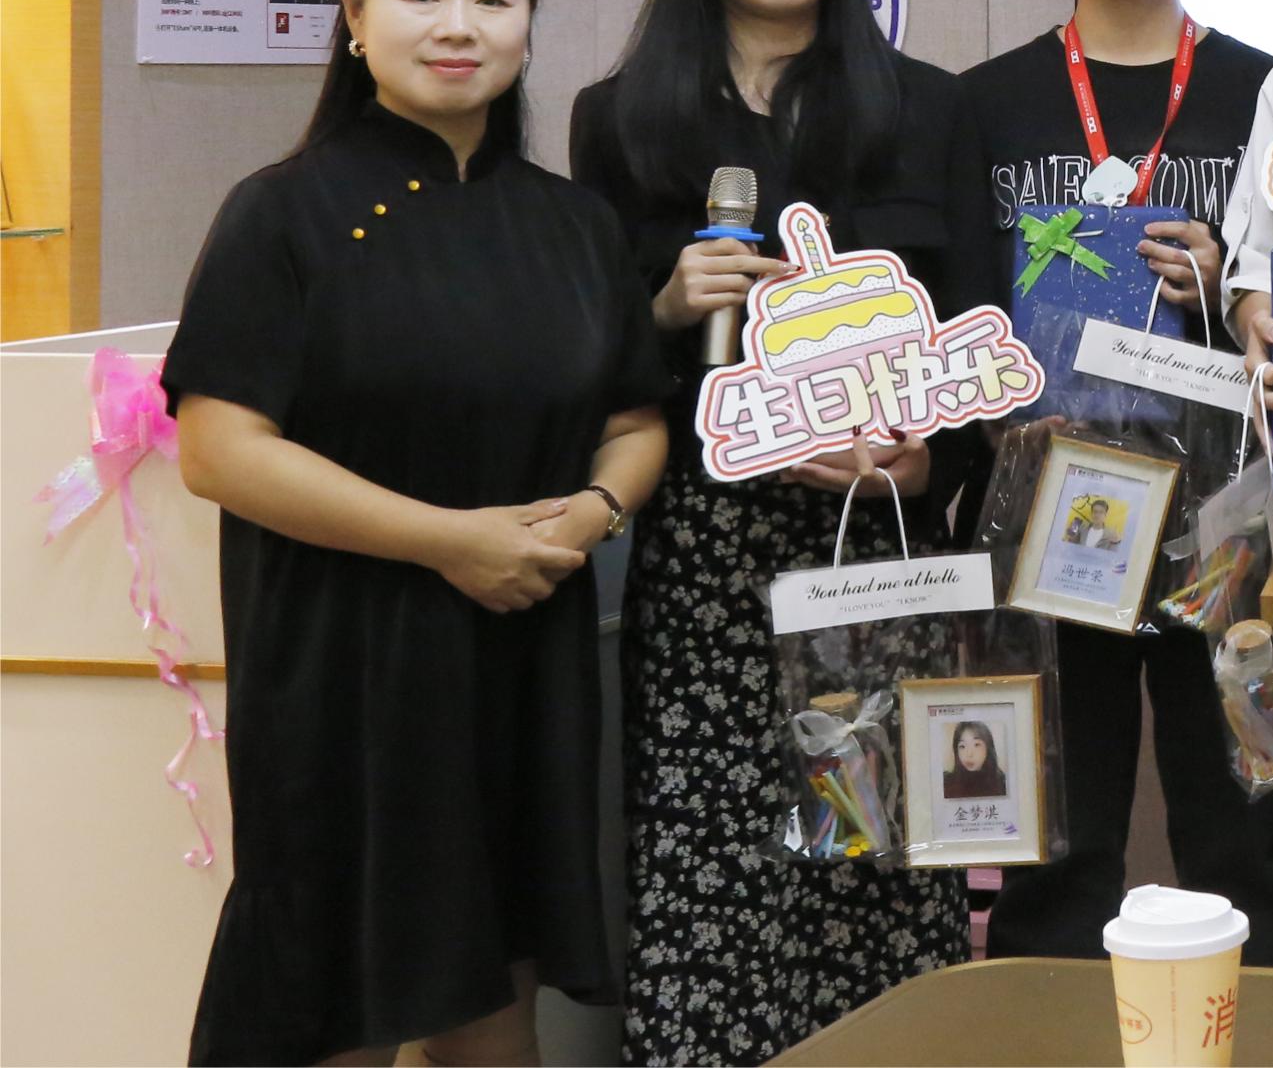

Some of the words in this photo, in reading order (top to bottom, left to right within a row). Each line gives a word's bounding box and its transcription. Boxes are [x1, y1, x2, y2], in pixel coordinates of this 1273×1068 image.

[1112, 338, 1139, 356] You
[1142, 347, 1173, 365] had
[1171, 359, 1193, 372] me
[716, 321, 1030, 465] 生日快乐
[807, 583, 838, 600] You
[841, 577, 875, 597] had
[877, 580, 901, 593] me
[924, 568, 962, 585] hello
[1202, 988, 1238, 1048] 消
